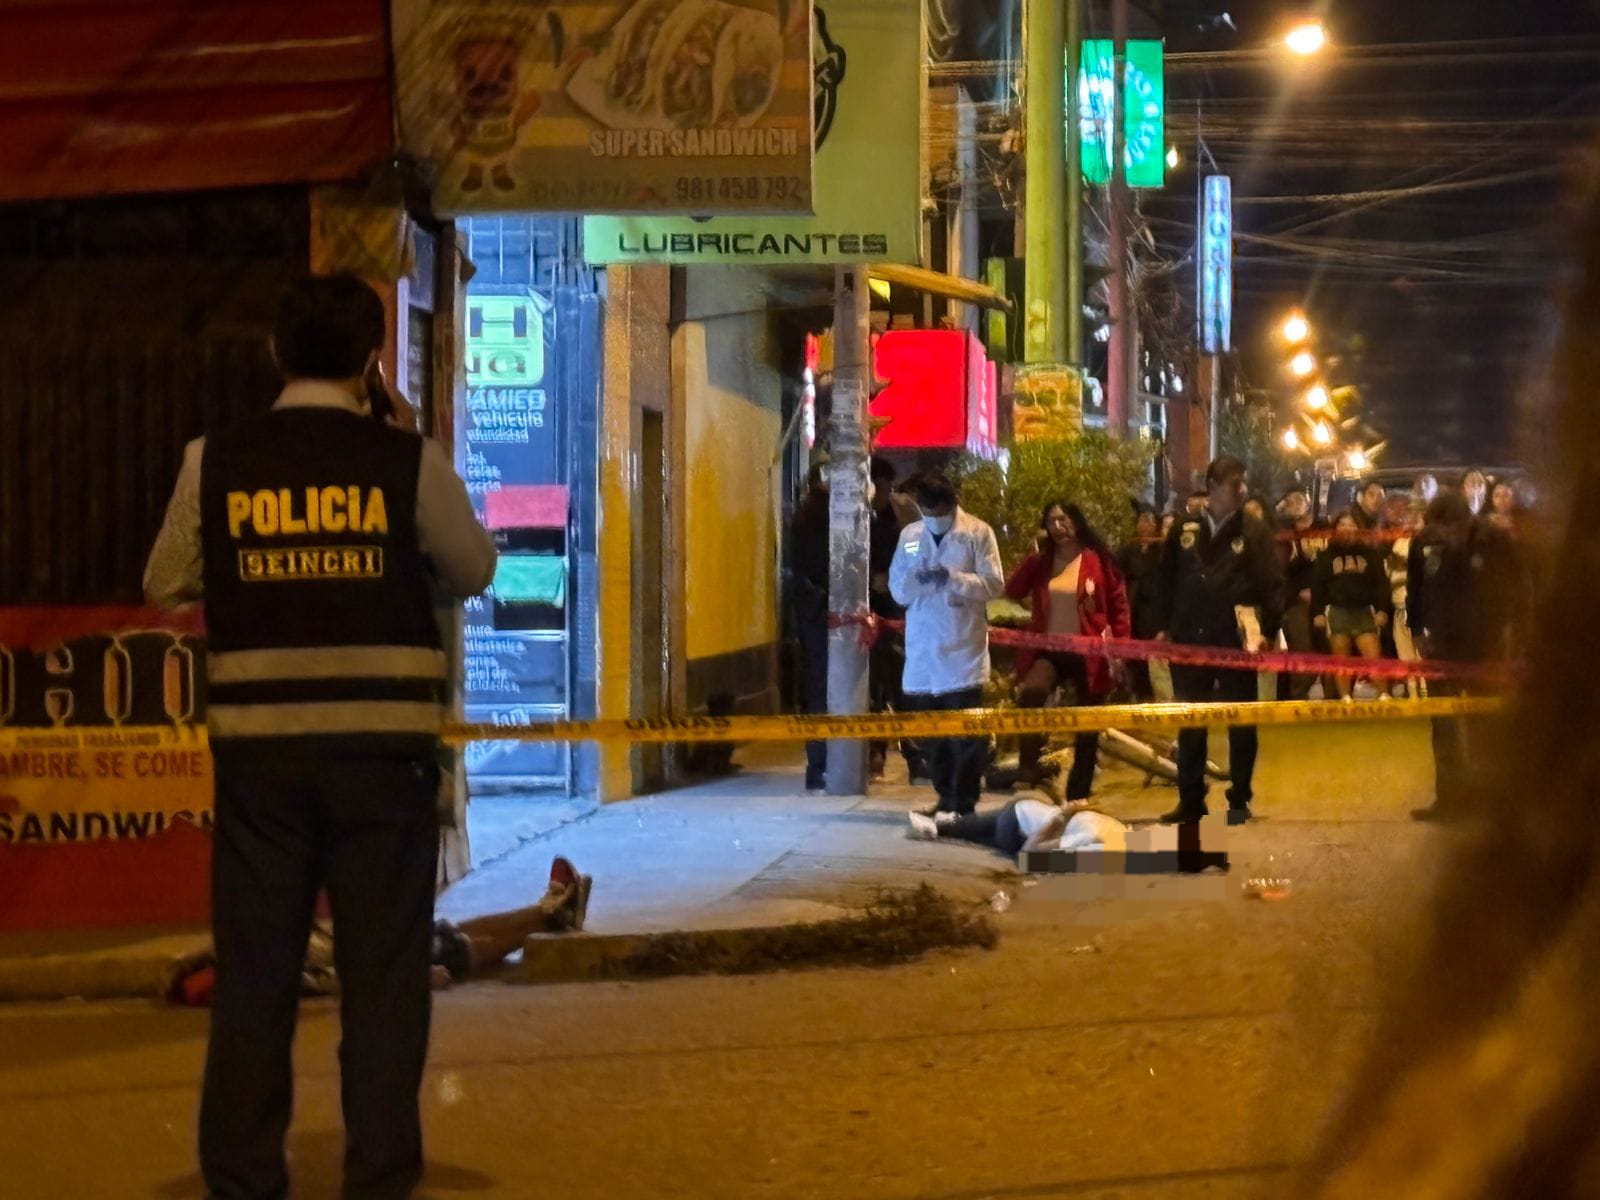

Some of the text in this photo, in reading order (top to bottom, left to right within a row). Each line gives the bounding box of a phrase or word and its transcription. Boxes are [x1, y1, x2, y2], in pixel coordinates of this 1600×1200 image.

[670, 128, 798, 157] SANDWICH
[618, 233, 888, 255] LUBRICANTES
[227, 485, 388, 538] POLICIA
[95, 751, 128, 779] SE
[133, 751, 204, 779] COME
